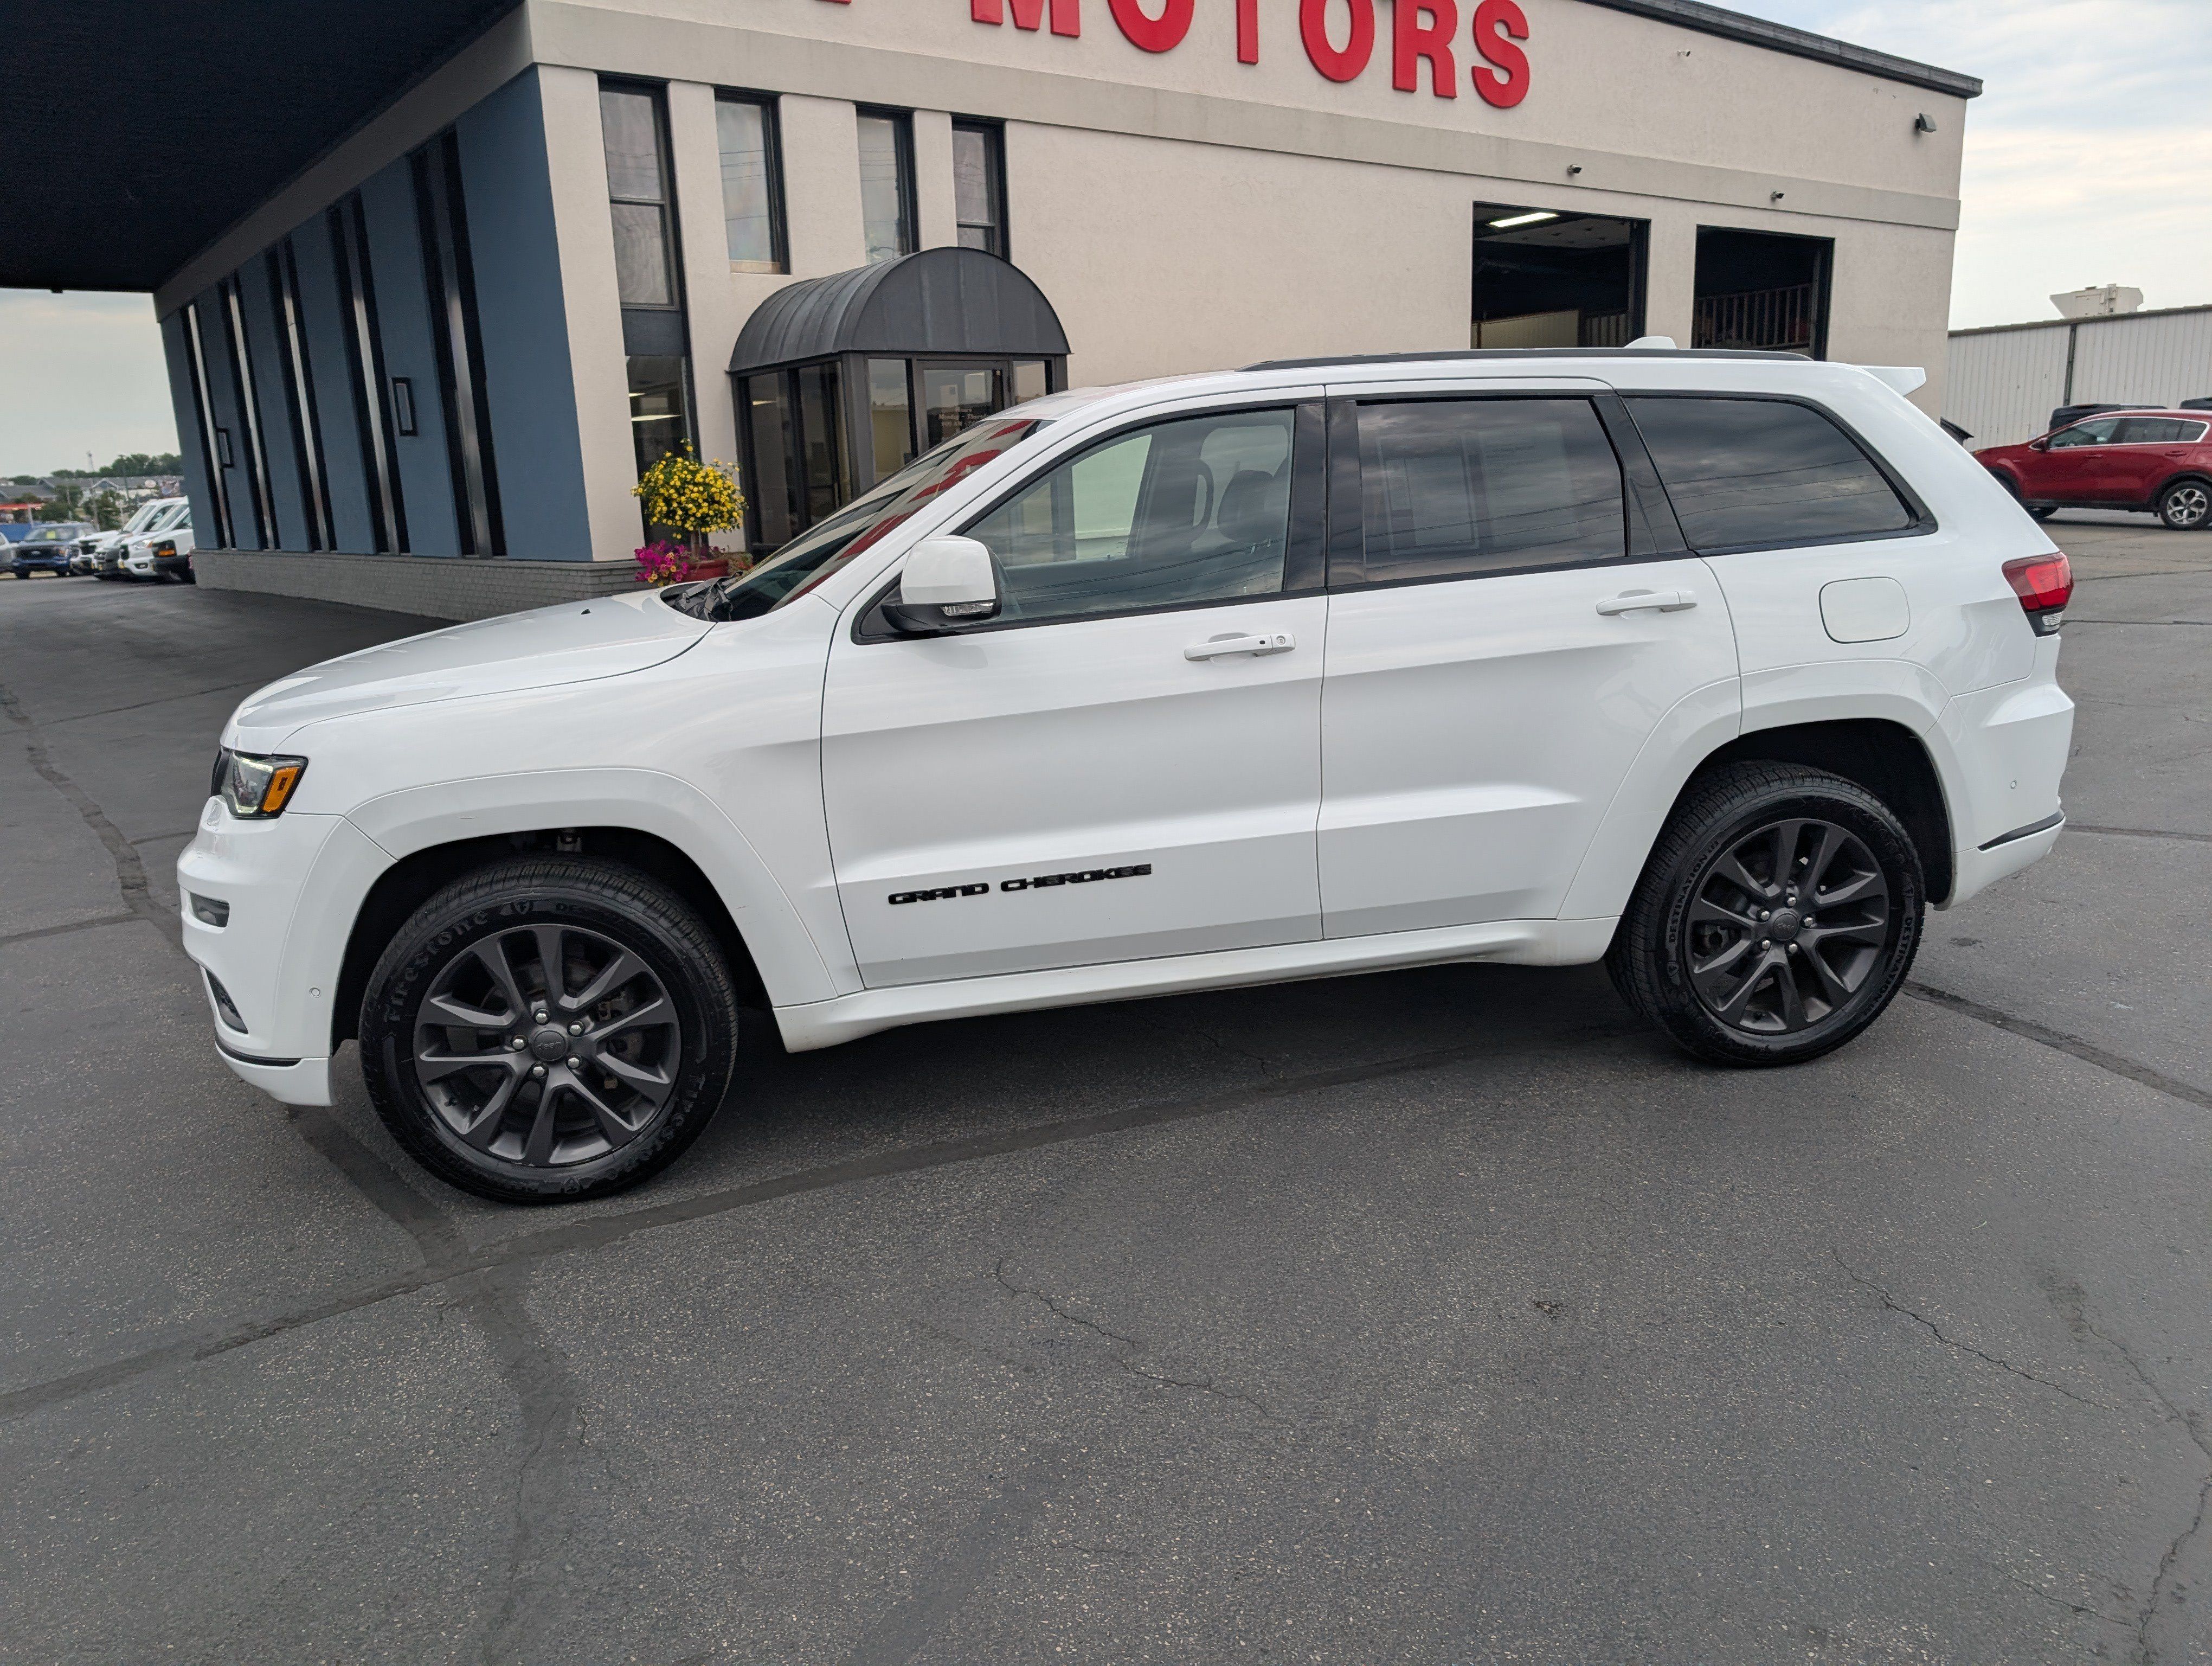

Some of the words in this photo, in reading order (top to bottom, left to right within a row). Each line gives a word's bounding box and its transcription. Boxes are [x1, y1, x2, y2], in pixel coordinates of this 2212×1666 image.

[888, 882, 989, 905] GRAND
[1000, 863, 1152, 892] CHEROKEE
[1668, 854, 1708, 943] DESTINATION
[384, 911, 488, 1023] Firestone
